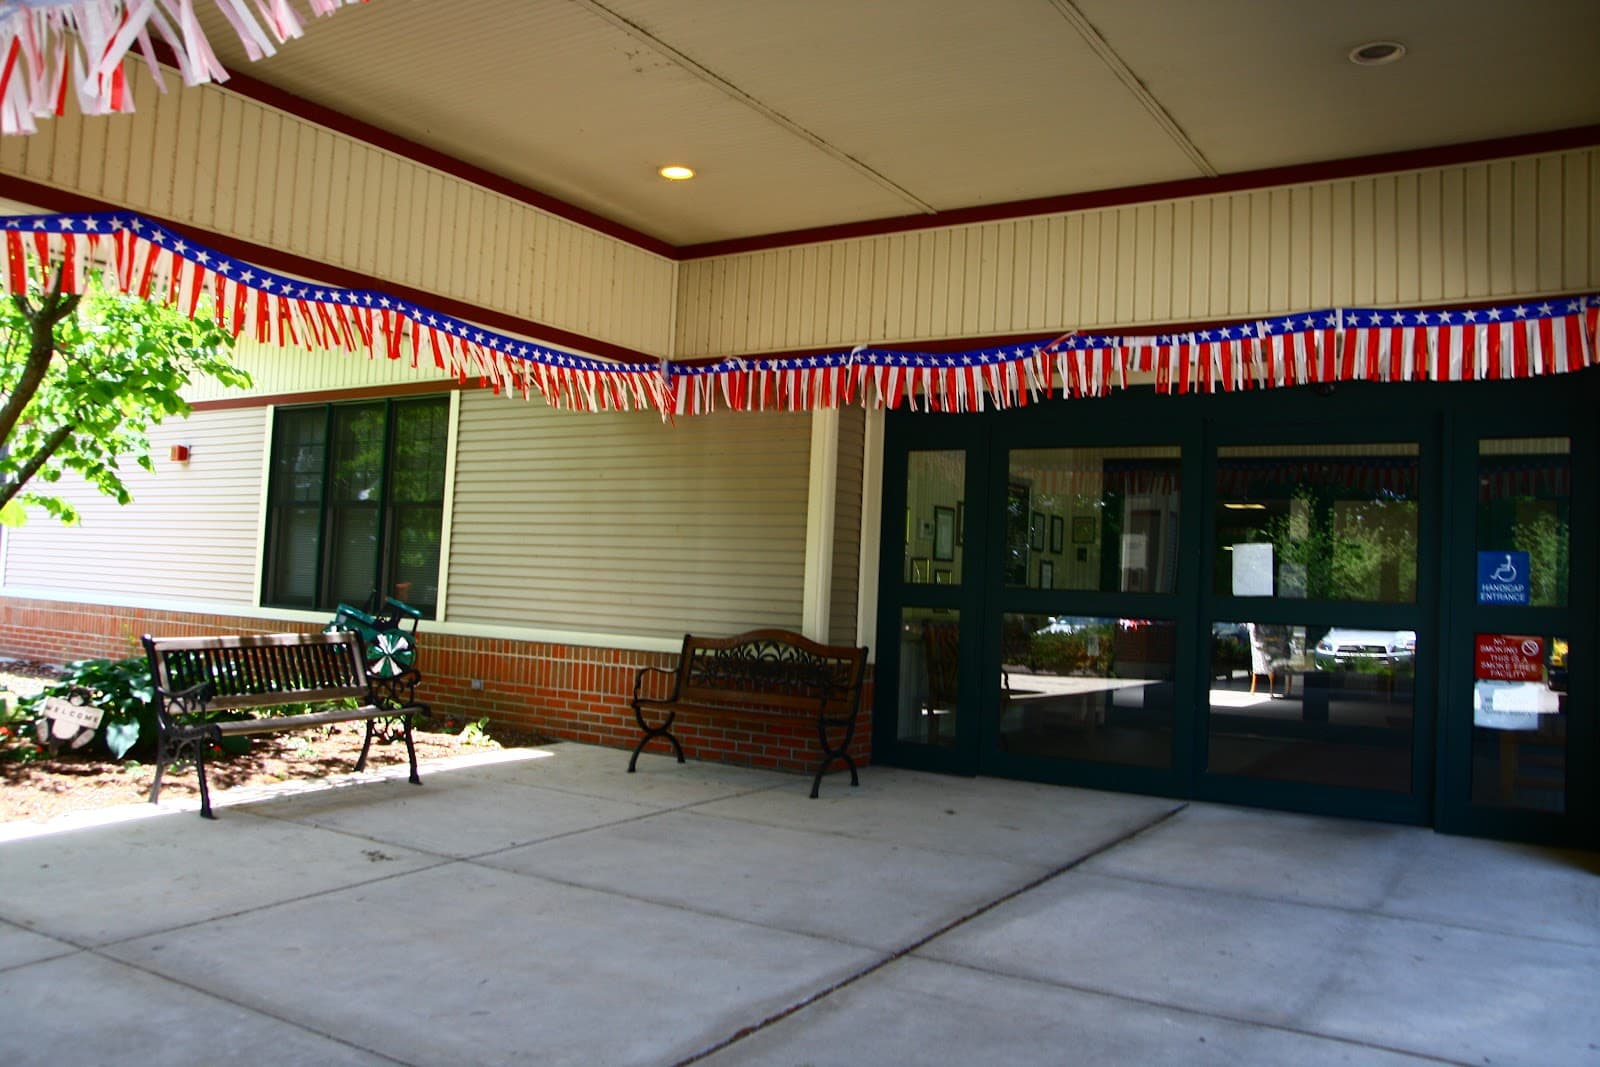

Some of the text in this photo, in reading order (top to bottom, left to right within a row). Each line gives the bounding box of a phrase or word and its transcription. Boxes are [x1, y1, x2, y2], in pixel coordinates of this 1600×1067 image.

[1481, 583, 1525, 593] HANDICAP
[1480, 592, 1525, 601] ENTRANCE
[1493, 638, 1506, 646] NO
[1480, 645, 1519, 654] SMOKING
[1481, 661, 1537, 672] SMOKE FREE
[1490, 670, 1527, 679] FACILITY
[46, 704, 99, 723] WELCOME
